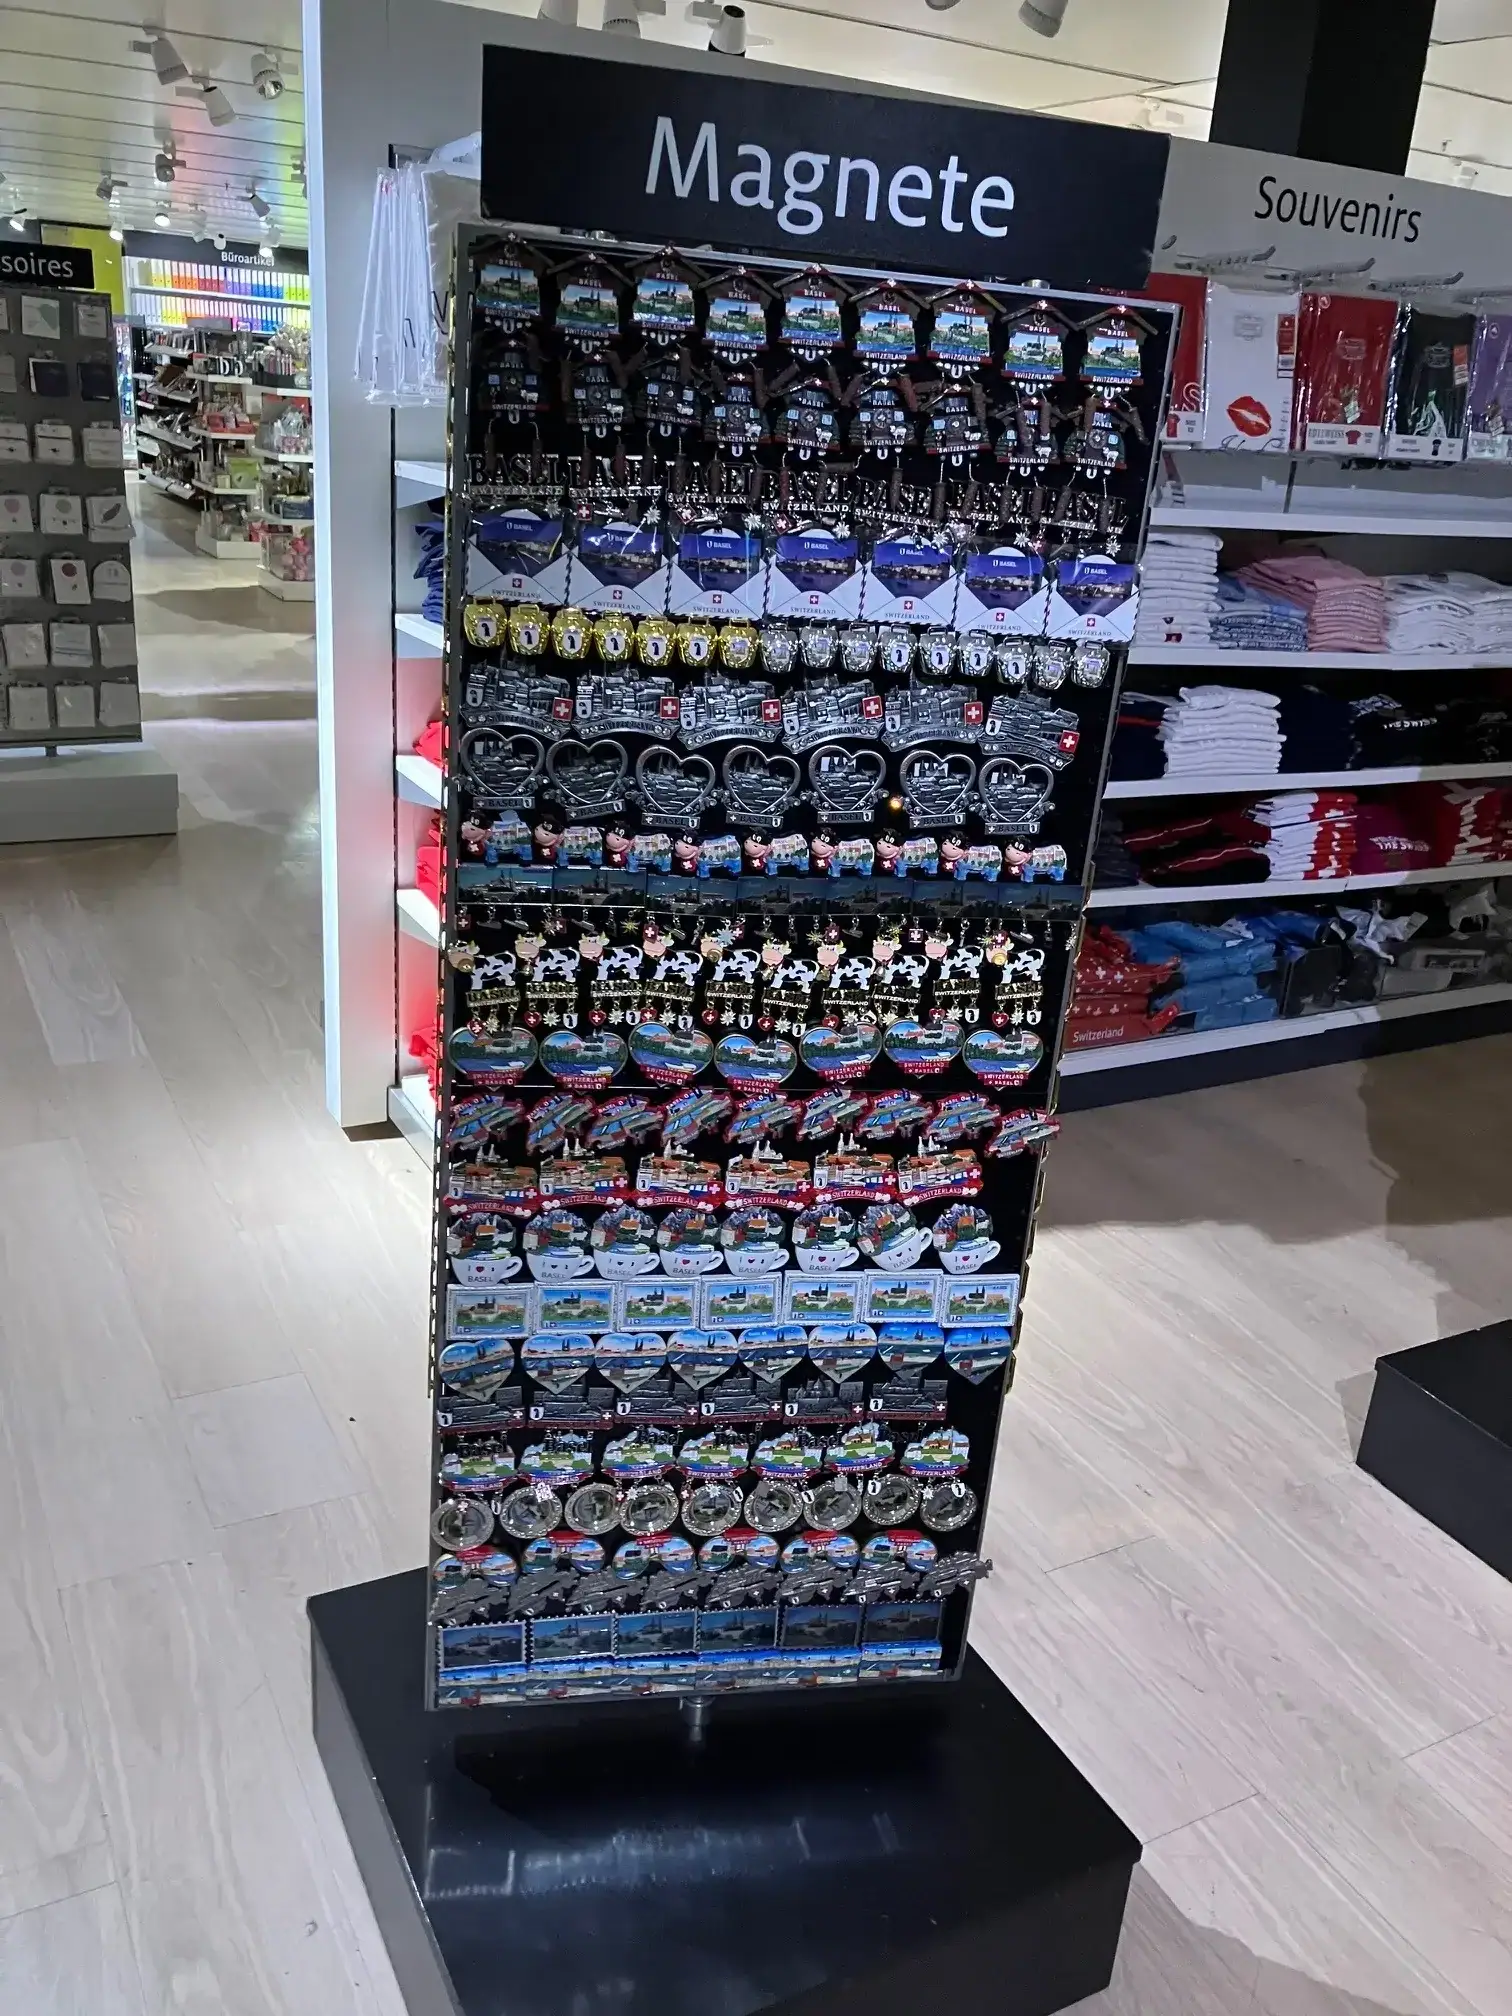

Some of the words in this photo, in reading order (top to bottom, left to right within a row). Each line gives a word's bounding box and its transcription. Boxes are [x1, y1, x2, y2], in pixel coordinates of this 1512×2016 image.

[645, 116, 1015, 238] Magnete
[1255, 176, 1421, 243] Souvenirs
[221, 251, 275, 267] Büroartikel
[485, 308, 531, 319] SWITZERLAND
[642, 322, 686, 332] SWITZERLAND
[564, 327, 610, 338] SWITZERLAND
[714, 340, 757, 350] SWITZERLAND
[791, 338, 833, 347] SWITZERLAND
[865, 352, 907, 361] SWITZERLAND
[939, 352, 981, 363] SWITZERLAND
[1014, 372, 1055, 381] SWITZERLAND
[1092, 376, 1133, 385] SWITZERLAND
[513, 524, 533, 532] BASEL
[713, 541, 732, 549] BASEL
[810, 542, 829, 550] BASEL
[906, 549, 924, 557] BASEL
[999, 560, 1017, 568] BASEL
[1090, 568, 1108, 576] BASEL
[491, 589, 541, 599] SWITZERLAND
[593, 601, 641, 611] SWITZERLAND
[692, 606, 740, 615] SWITZERLAND
[790, 606, 836, 615] SWITZERLAND
[884, 612, 930, 621] SWITZERLAND
[977, 624, 1022, 632] SWITZERLAND
[1068, 629, 1112, 638] SWITZERLAND
[487, 800, 518, 808] BASEL
[578, 803, 612, 818] BASEL
[654, 816, 687, 825] BASEL
[739, 816, 770, 825] BASEL
[831, 813, 863, 821] BASEL
[923, 816, 954, 825] BASEL
[998, 825, 1028, 833] BASEL
[645, 991, 692, 1001] SWITZERLAND
[874, 994, 918, 1004] SWITZERLAND
[997, 991, 1042, 1000] SWITZERLAND
[469, 997, 519, 1007] SWITZERLAND
[764, 999, 808, 1009] SWITZERLAND
[1073, 1025, 1125, 1043] Switzerland
[646, 1067, 688, 1080] SWITZERLAND
[824, 1065, 867, 1077] SWITZERLAND
[562, 1076, 607, 1084] SWITZERLAND
[733, 1079, 775, 1088] SWITZERLAND
[832, 1190, 875, 1200] SWITZERLAND
[918, 1186, 963, 1200] SWITZERLAND
[560, 1195, 607, 1206] SWITZERLAND
[653, 1196, 700, 1207] SWITZERLAND
[743, 1197, 788, 1207] SWITZERLAND
[467, 1202, 514, 1214] SWITZERLAND
[892, 1255, 916, 1269] BASEL
[606, 1268, 632, 1276] BASEL
[809, 1264, 833, 1272] BASEL
[955, 1263, 978, 1272] BASEL
